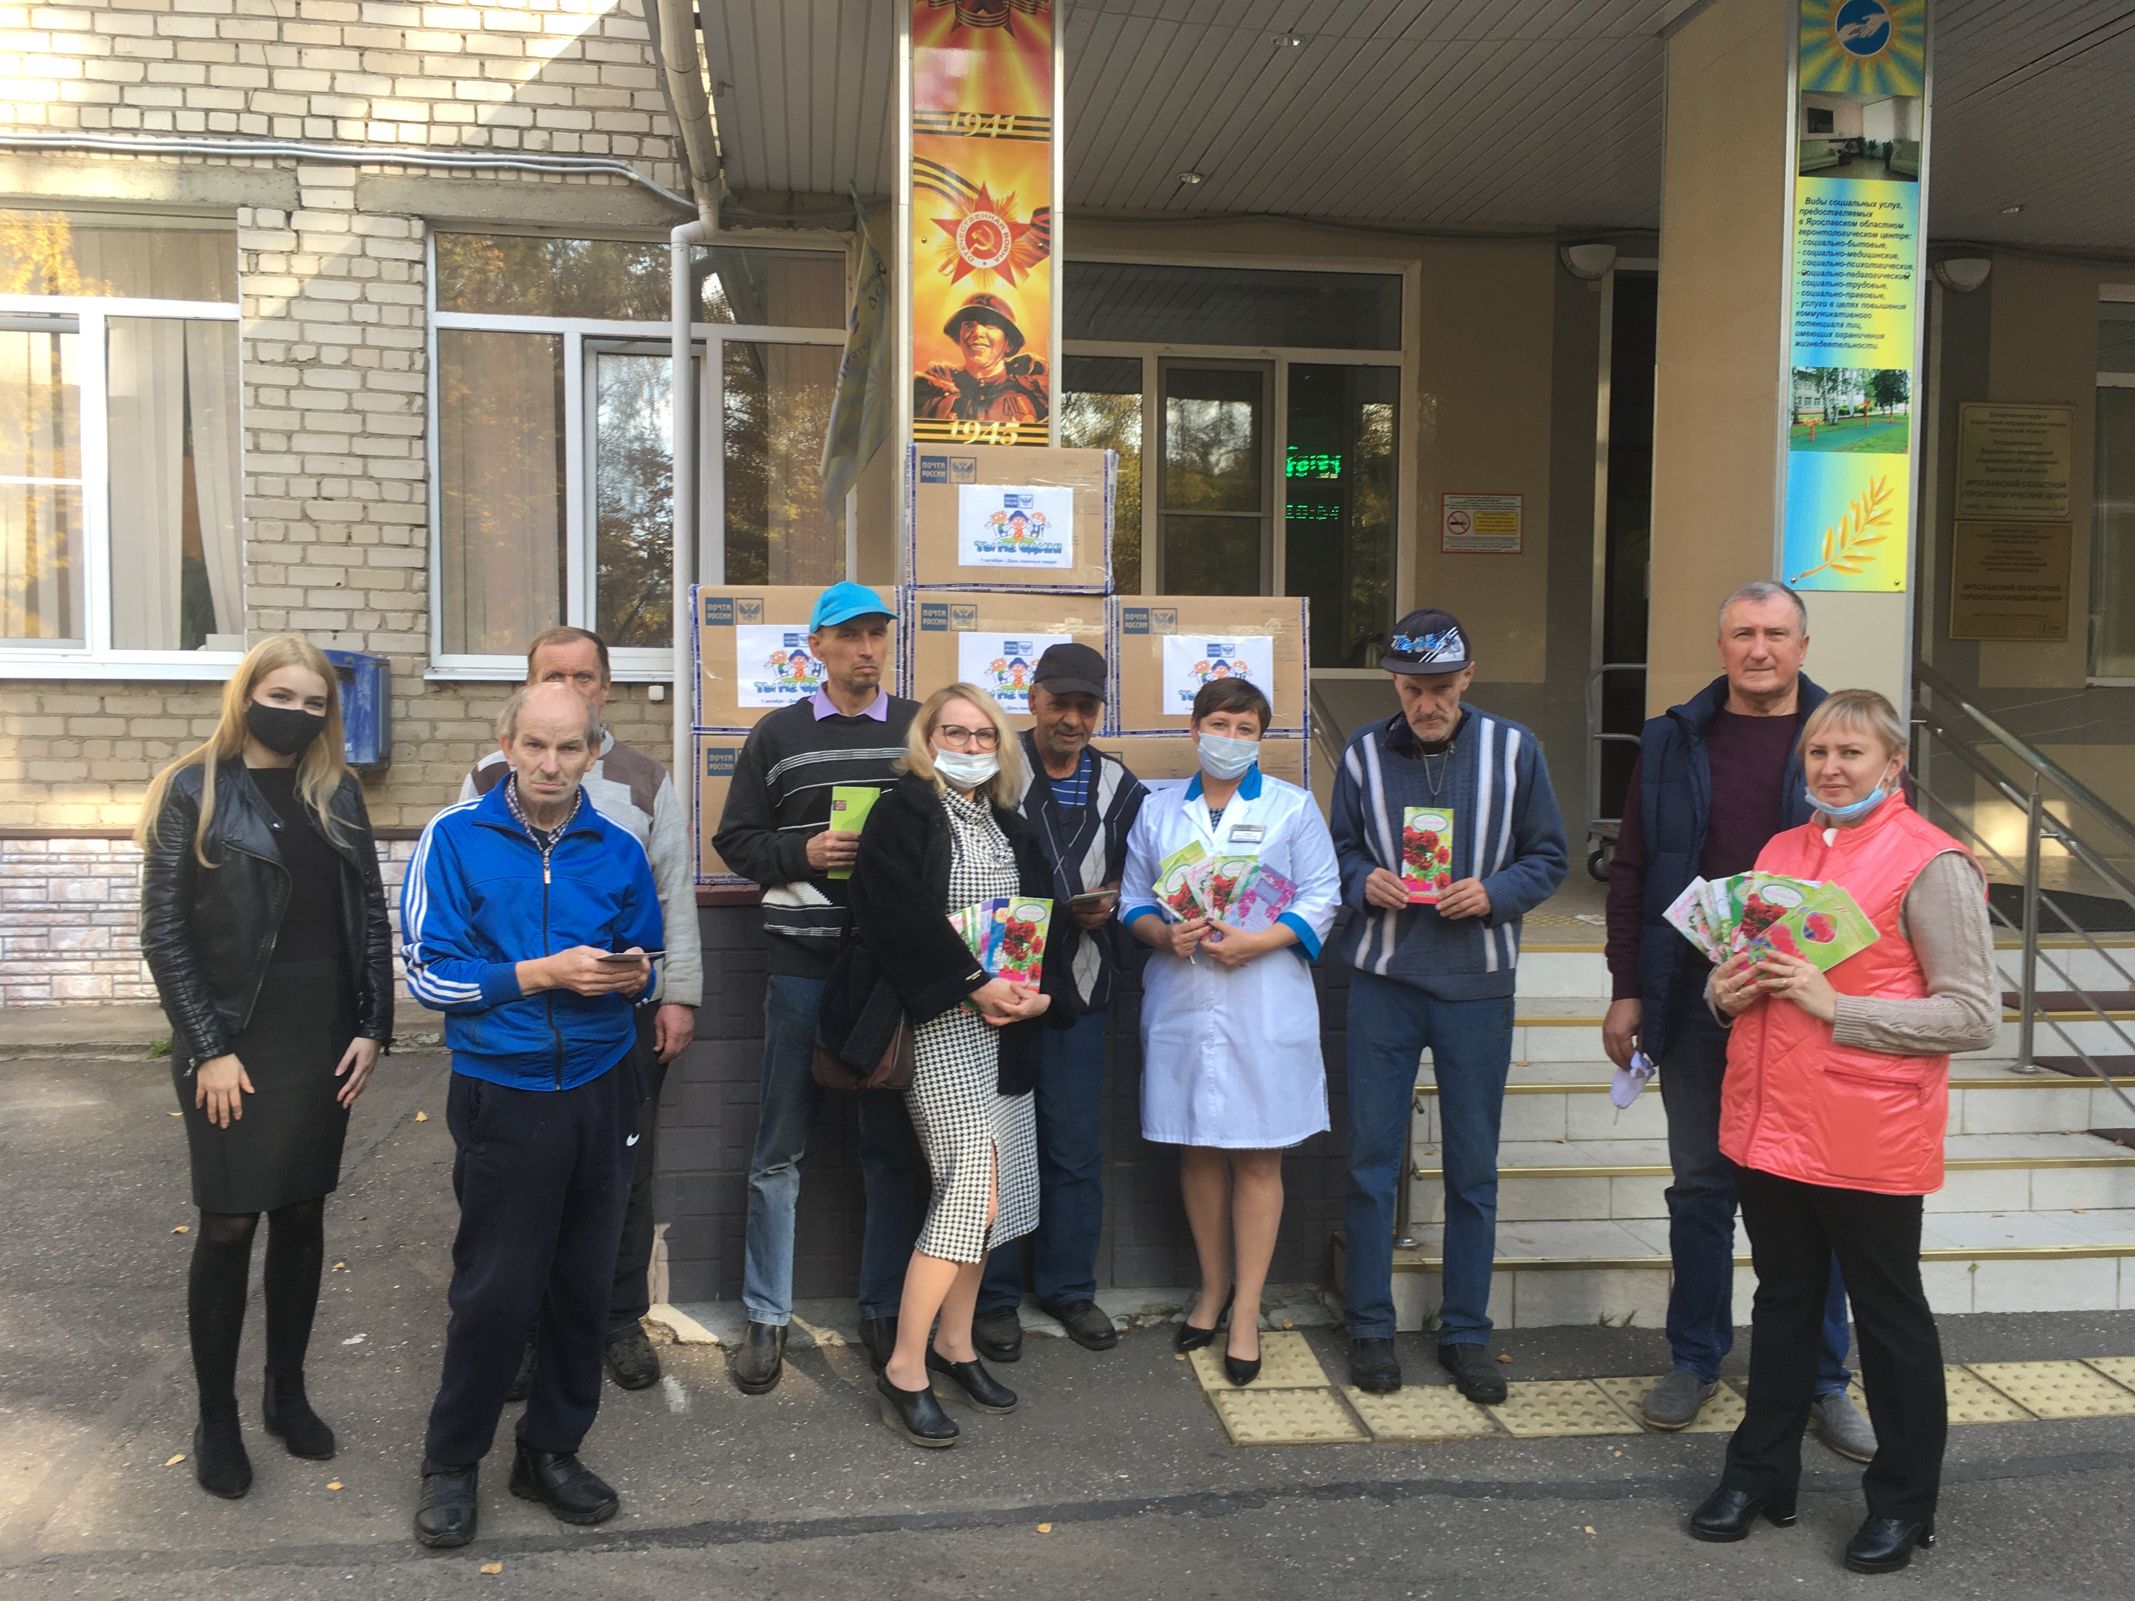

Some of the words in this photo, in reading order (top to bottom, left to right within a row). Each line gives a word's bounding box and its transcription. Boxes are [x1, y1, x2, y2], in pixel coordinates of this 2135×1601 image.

[951, 112, 1015, 138] 1941
[1804, 197, 1827, 206] Виды
[1829, 199, 1877, 208] социальных
[1798, 208, 1873, 218] предоставляемых
[1805, 218, 1858, 227] Ярославском
[1859, 220, 1904, 229] областном
[949, 420, 1020, 446] 1945
[922, 462, 946, 470] ПОЧТА
[922, 470, 946, 478] РОССИИ
[707, 604, 732, 612] ПОЧТА
[707, 612, 732, 620] РОССИИ
[1124, 613, 1148, 621] ПОЧТА
[922, 618, 947, 626] РОССИИ
[710, 754, 733, 762] ПОЧТА
